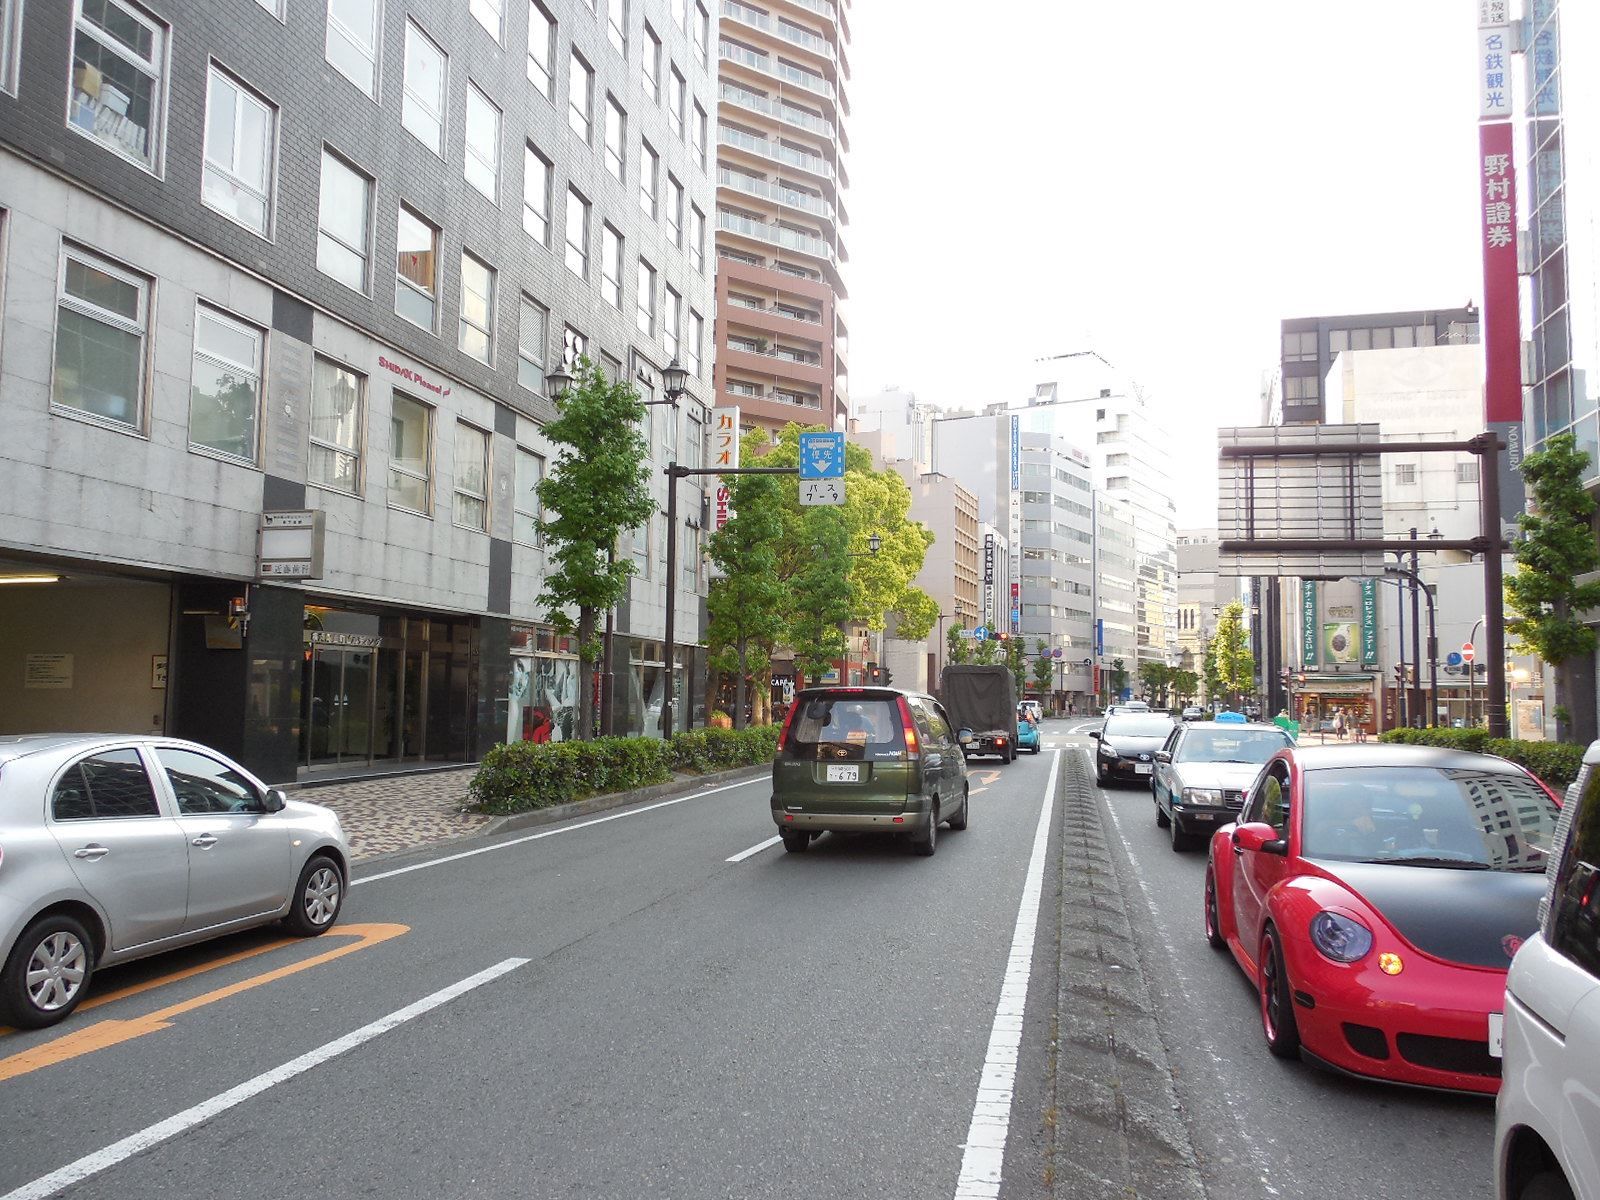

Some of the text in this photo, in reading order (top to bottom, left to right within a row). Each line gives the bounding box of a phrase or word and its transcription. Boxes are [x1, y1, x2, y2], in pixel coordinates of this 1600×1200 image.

[1485, 34, 1505, 108] 名鉄観光
[1484, 153, 1512, 248] 野村證券
[716, 413, 733, 476] カラオ
[811, 450, 833, 460] 優先
[1508, 425, 1519, 472] NOMURA
[809, 484, 835, 493] バス
